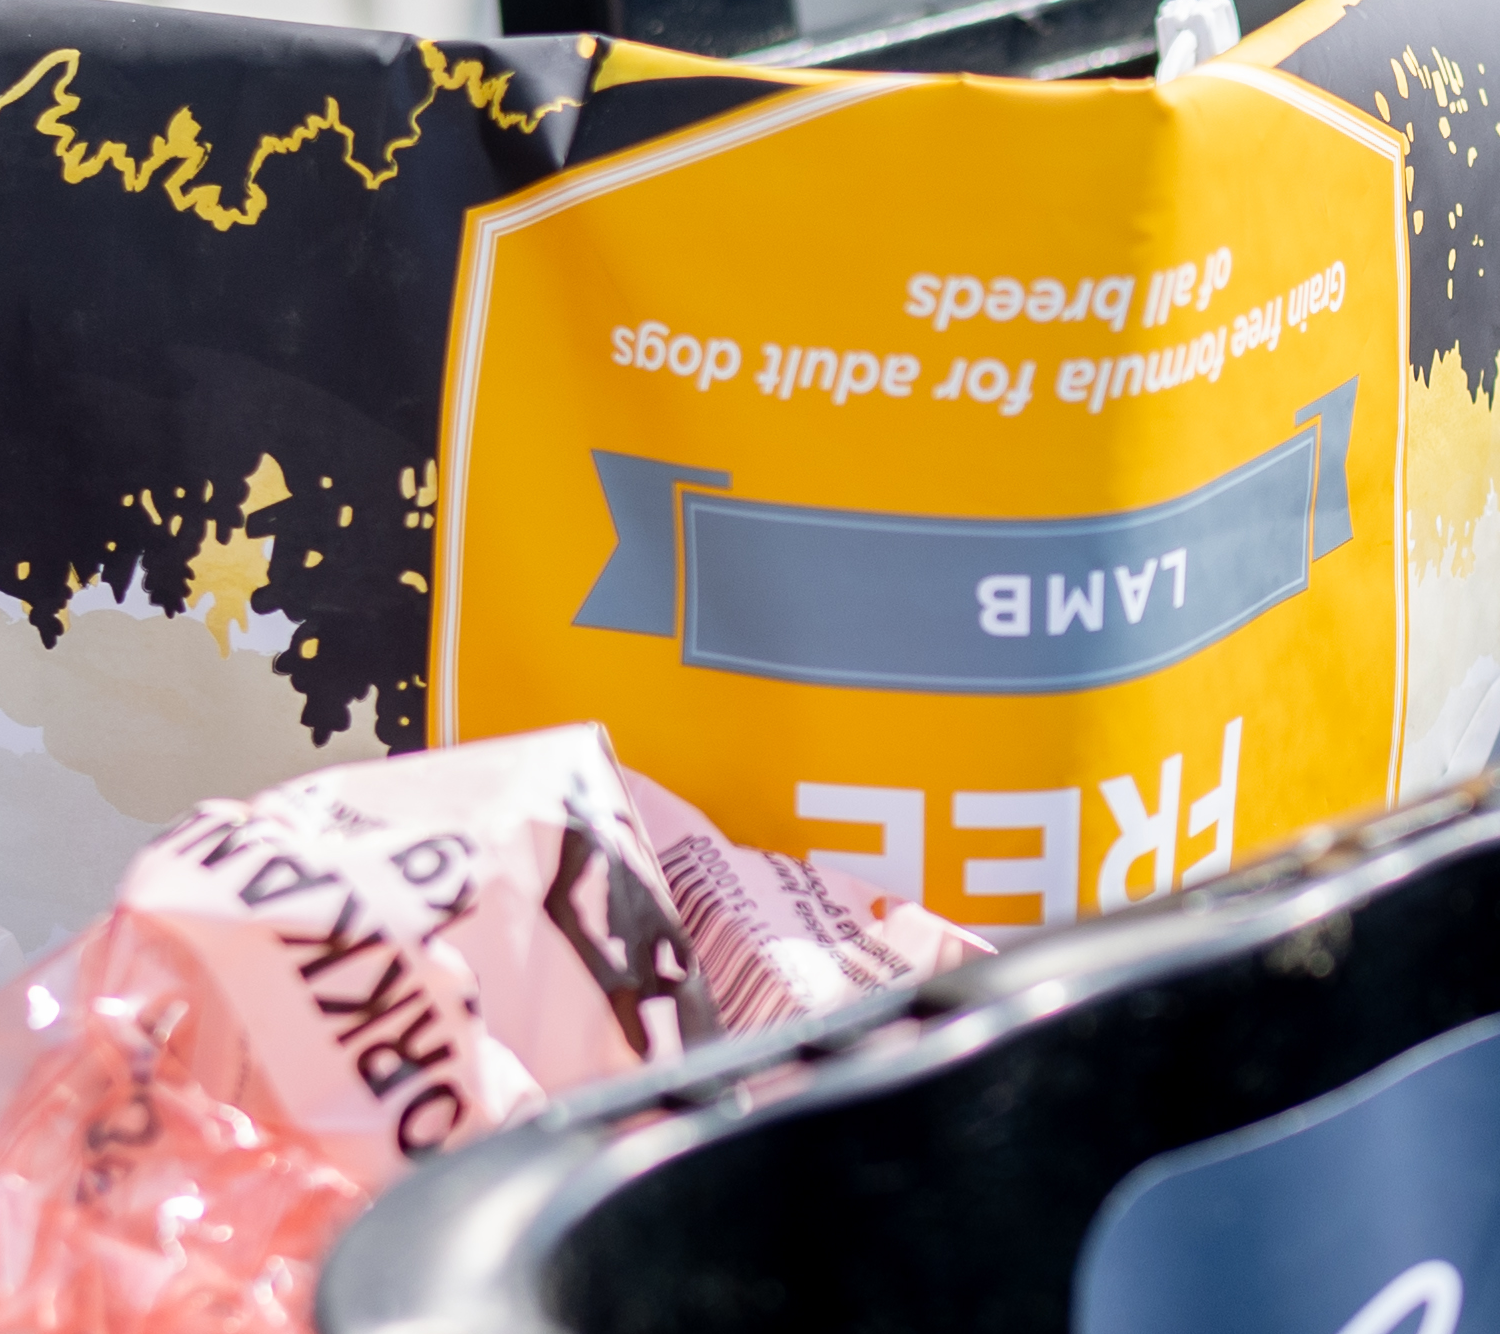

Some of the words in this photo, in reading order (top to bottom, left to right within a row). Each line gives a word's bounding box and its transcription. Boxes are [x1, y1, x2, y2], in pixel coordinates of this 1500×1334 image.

[905, 272, 1134, 332] breeds
[1140, 265, 1191, 331] all
[1193, 245, 1234, 300] of
[1290, 260, 1347, 328] Grain
[610, 323, 742, 397] dogs
[1230, 297, 1282, 360] free
[759, 342, 920, 405] adult
[934, 356, 1037, 418] for
[1056, 326, 1227, 415] formula
[977, 549, 1187, 639] LAMB
